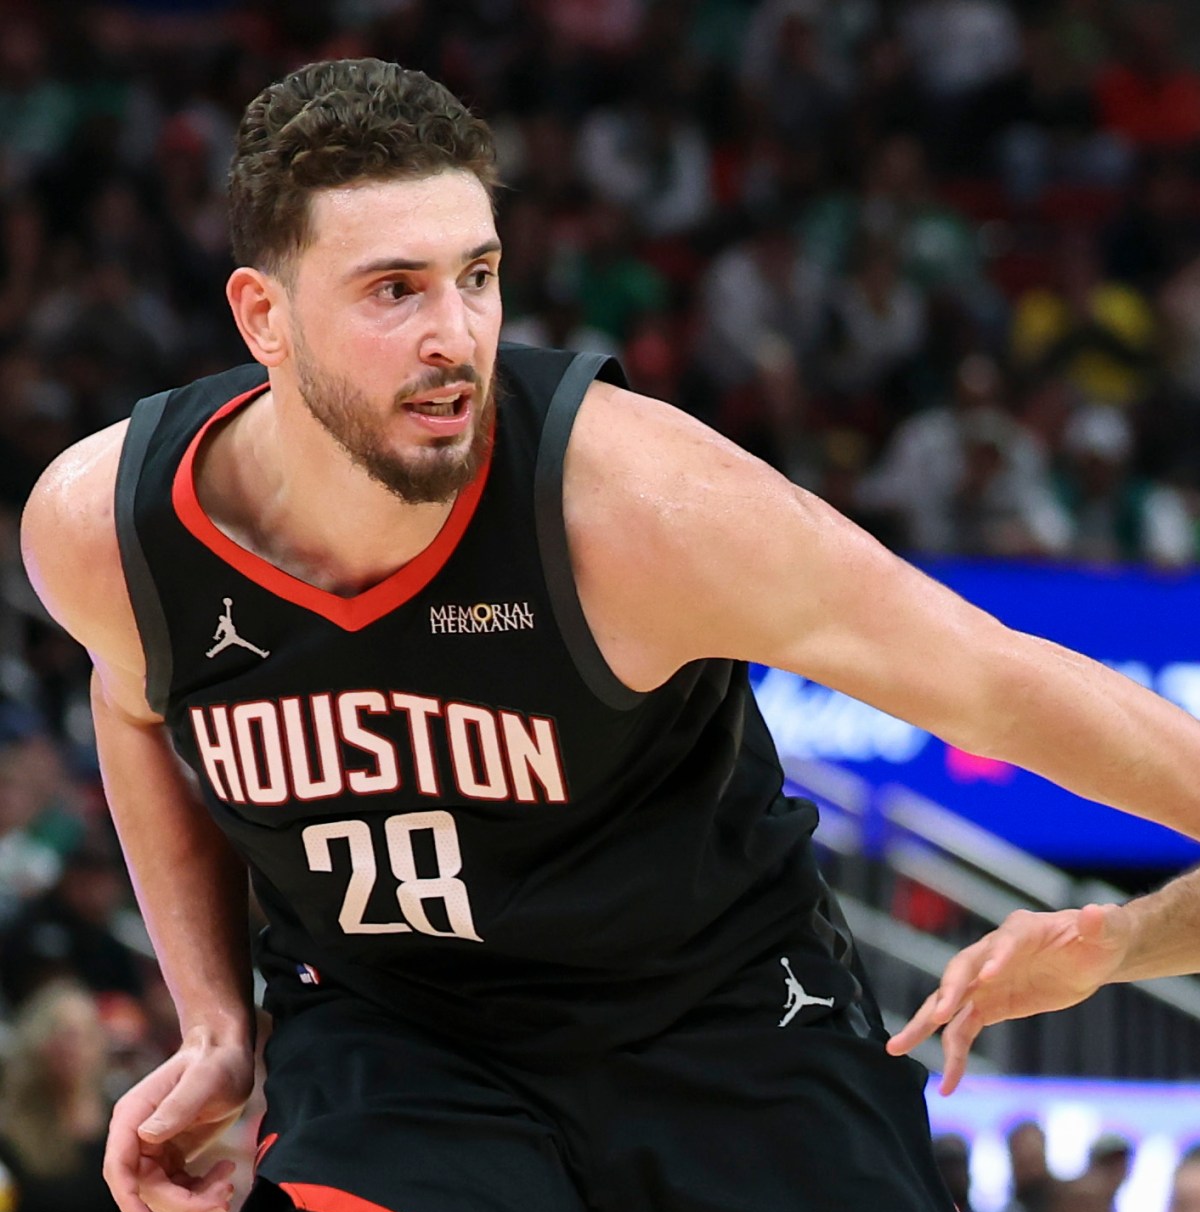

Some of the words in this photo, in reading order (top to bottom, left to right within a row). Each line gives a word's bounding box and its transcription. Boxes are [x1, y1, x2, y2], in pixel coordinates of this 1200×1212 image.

[430, 602, 534, 620] MEMORIAL
[431, 614, 534, 634] HERMANN
[189, 690, 568, 804] HOUSTON
[302, 810, 484, 943] 28
